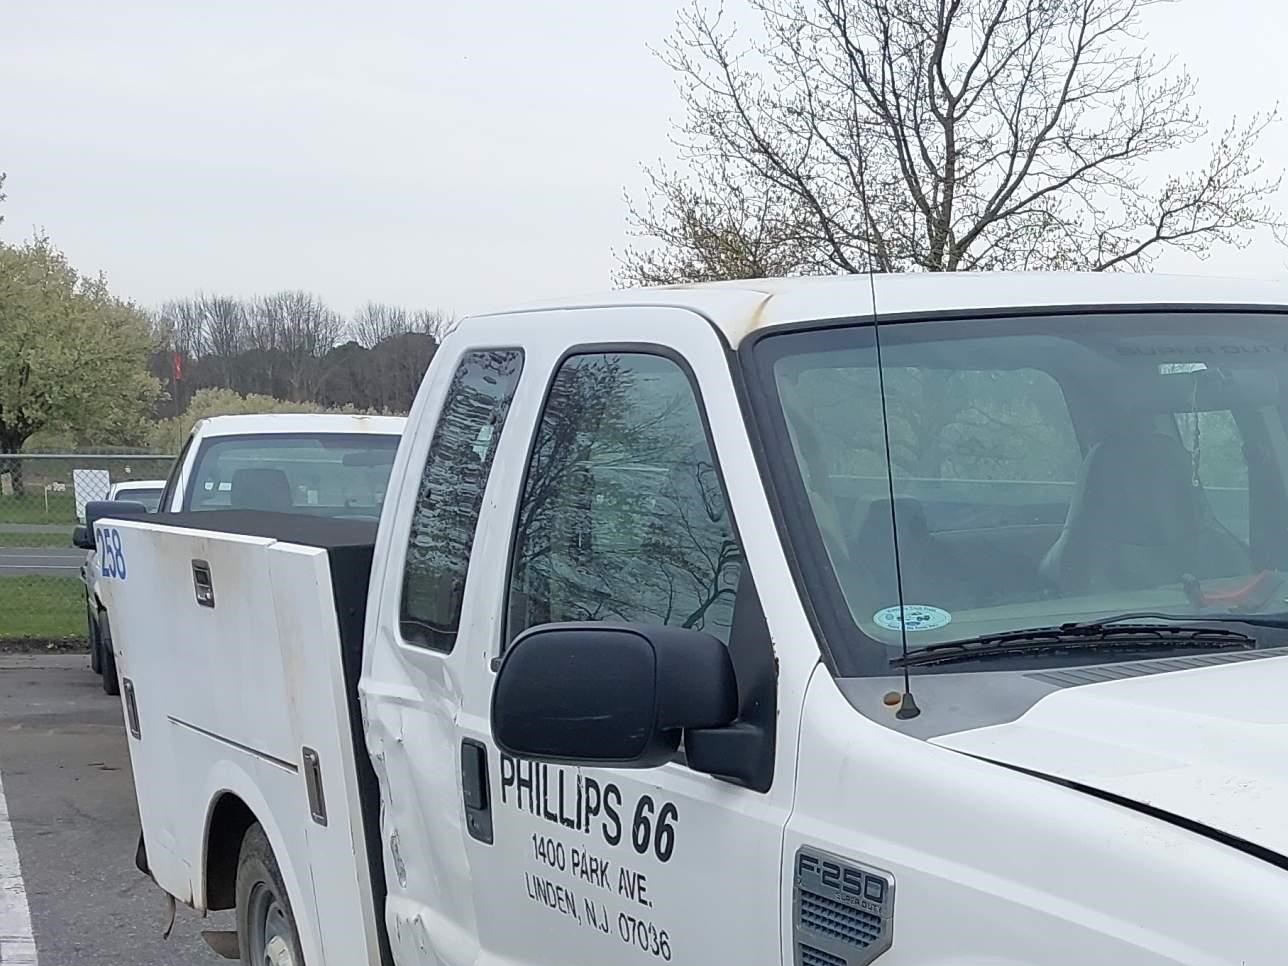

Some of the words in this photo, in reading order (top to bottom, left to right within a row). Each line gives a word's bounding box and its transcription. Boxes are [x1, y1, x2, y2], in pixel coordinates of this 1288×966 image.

[96, 527, 127, 580] 258
[500, 752, 623, 847] PHILLIPS
[632, 795, 679, 863] 66
[532, 833, 566, 872] 1400
[571, 846, 612, 892] PARK
[618, 867, 653, 908] AVE.
[525, 872, 582, 926] LINDEN,
[618, 912, 672, 962] 07036
